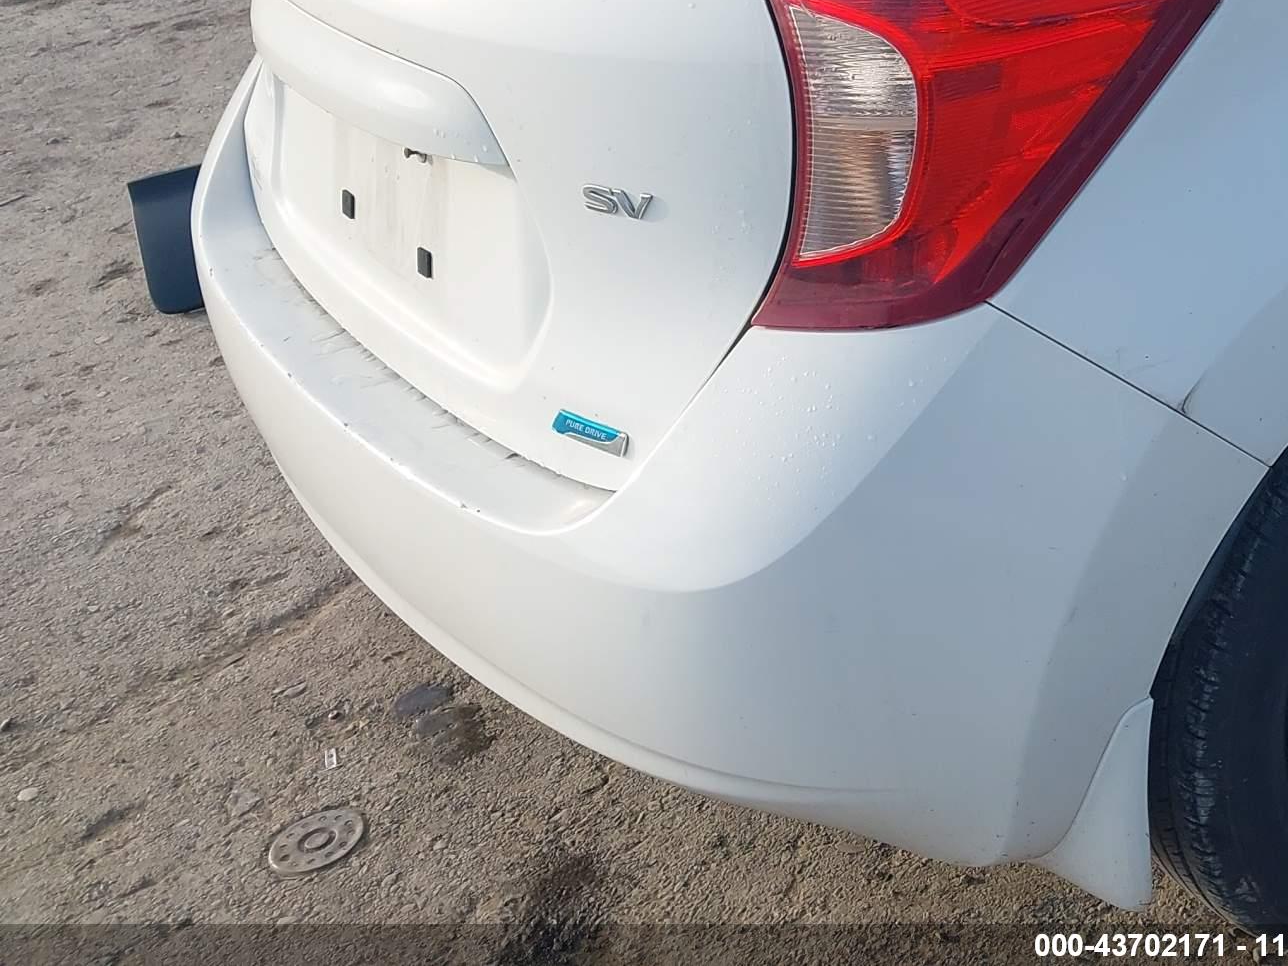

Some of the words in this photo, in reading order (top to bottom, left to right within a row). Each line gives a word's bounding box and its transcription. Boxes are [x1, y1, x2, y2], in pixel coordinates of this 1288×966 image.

[582, 183, 653, 220] SV
[565, 418, 584, 432] PURE
[585, 426, 608, 440] DRIVE
